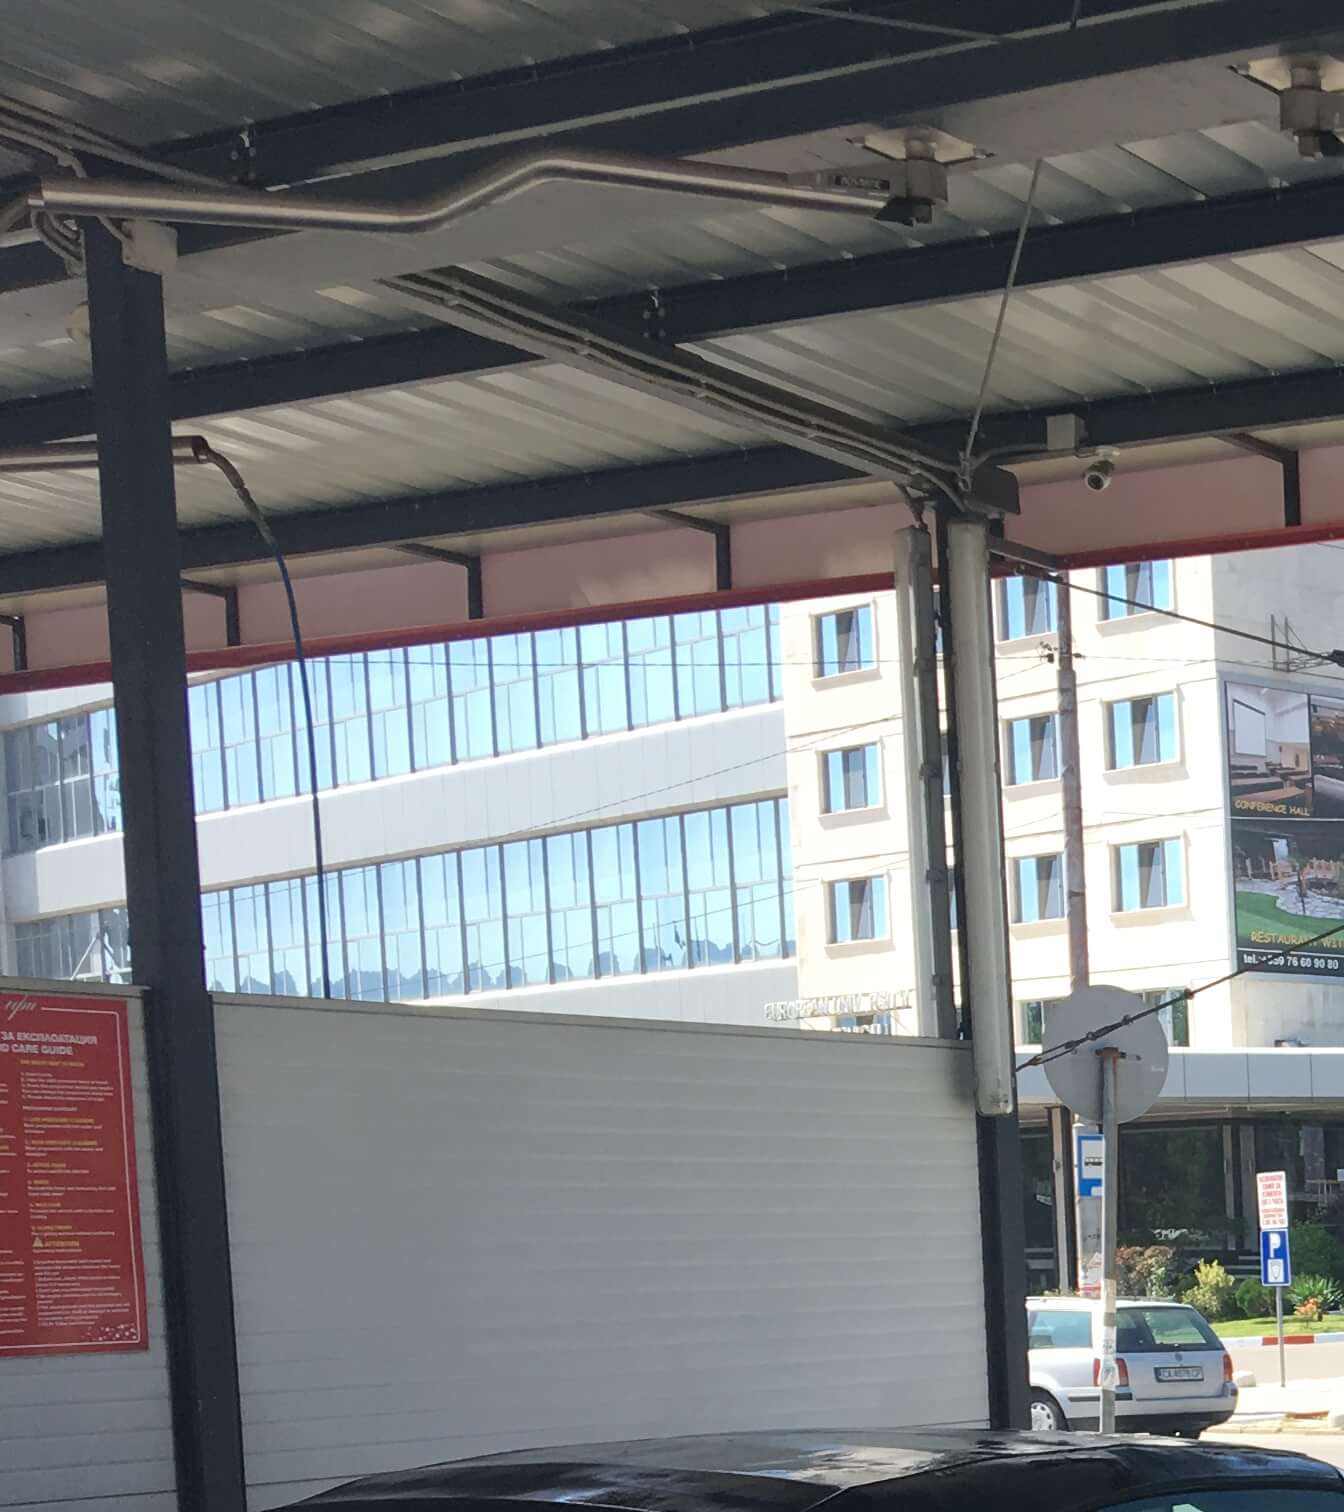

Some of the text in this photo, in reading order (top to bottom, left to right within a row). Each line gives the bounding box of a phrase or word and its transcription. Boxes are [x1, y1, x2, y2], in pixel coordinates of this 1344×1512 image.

[1235, 799, 1311, 817] CONFERENCE HALL
[1313, 958, 1325, 968] 90
[1269, 1232, 1281, 1259] P
